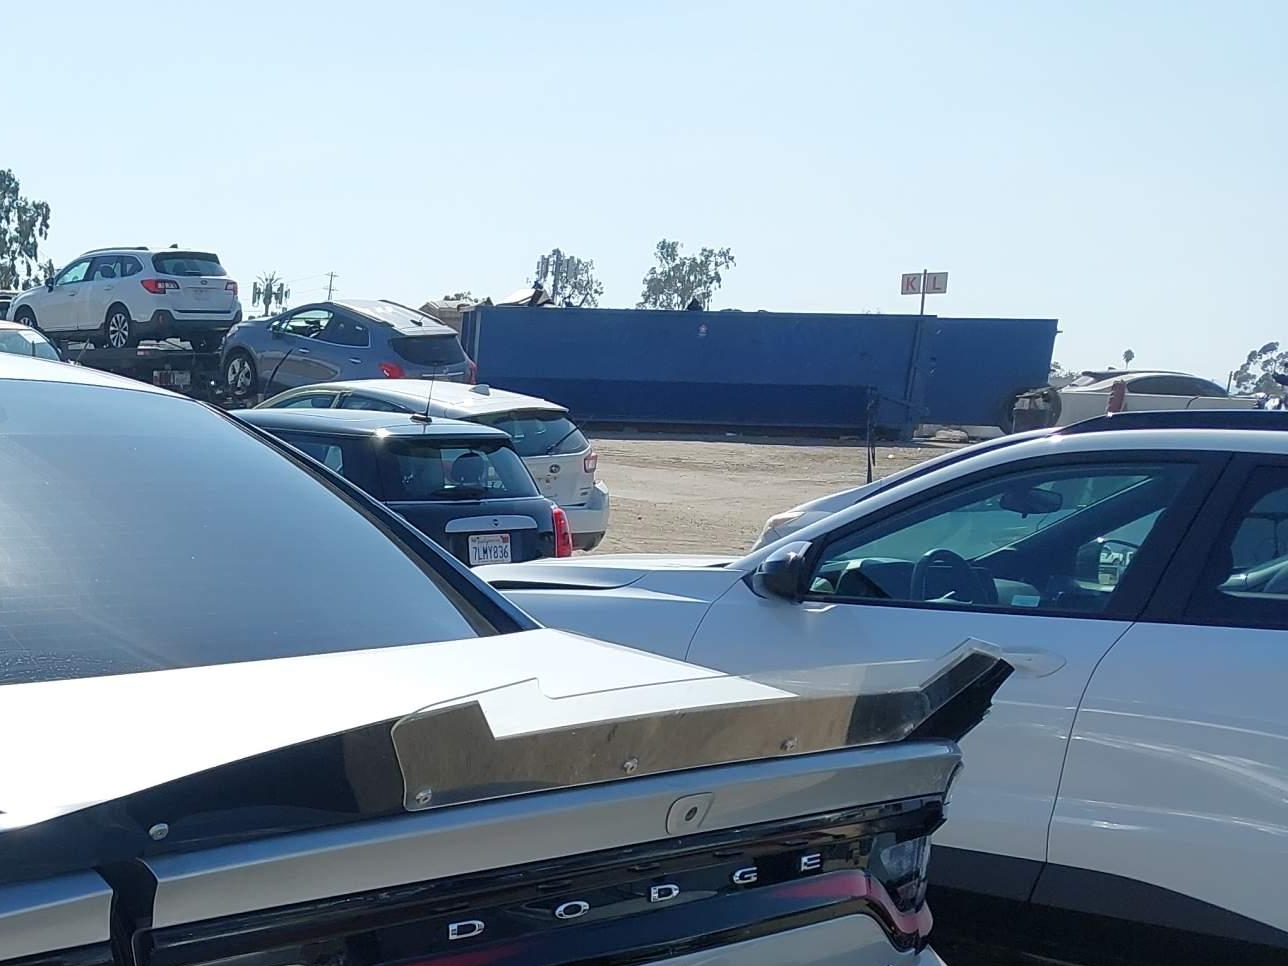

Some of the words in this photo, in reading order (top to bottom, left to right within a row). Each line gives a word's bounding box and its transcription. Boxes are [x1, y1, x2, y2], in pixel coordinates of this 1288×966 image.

[905, 276, 917, 291] K
[932, 276, 942, 290] L
[472, 544, 509, 561] 7LMY836
[448, 852, 822, 940] DODGE
